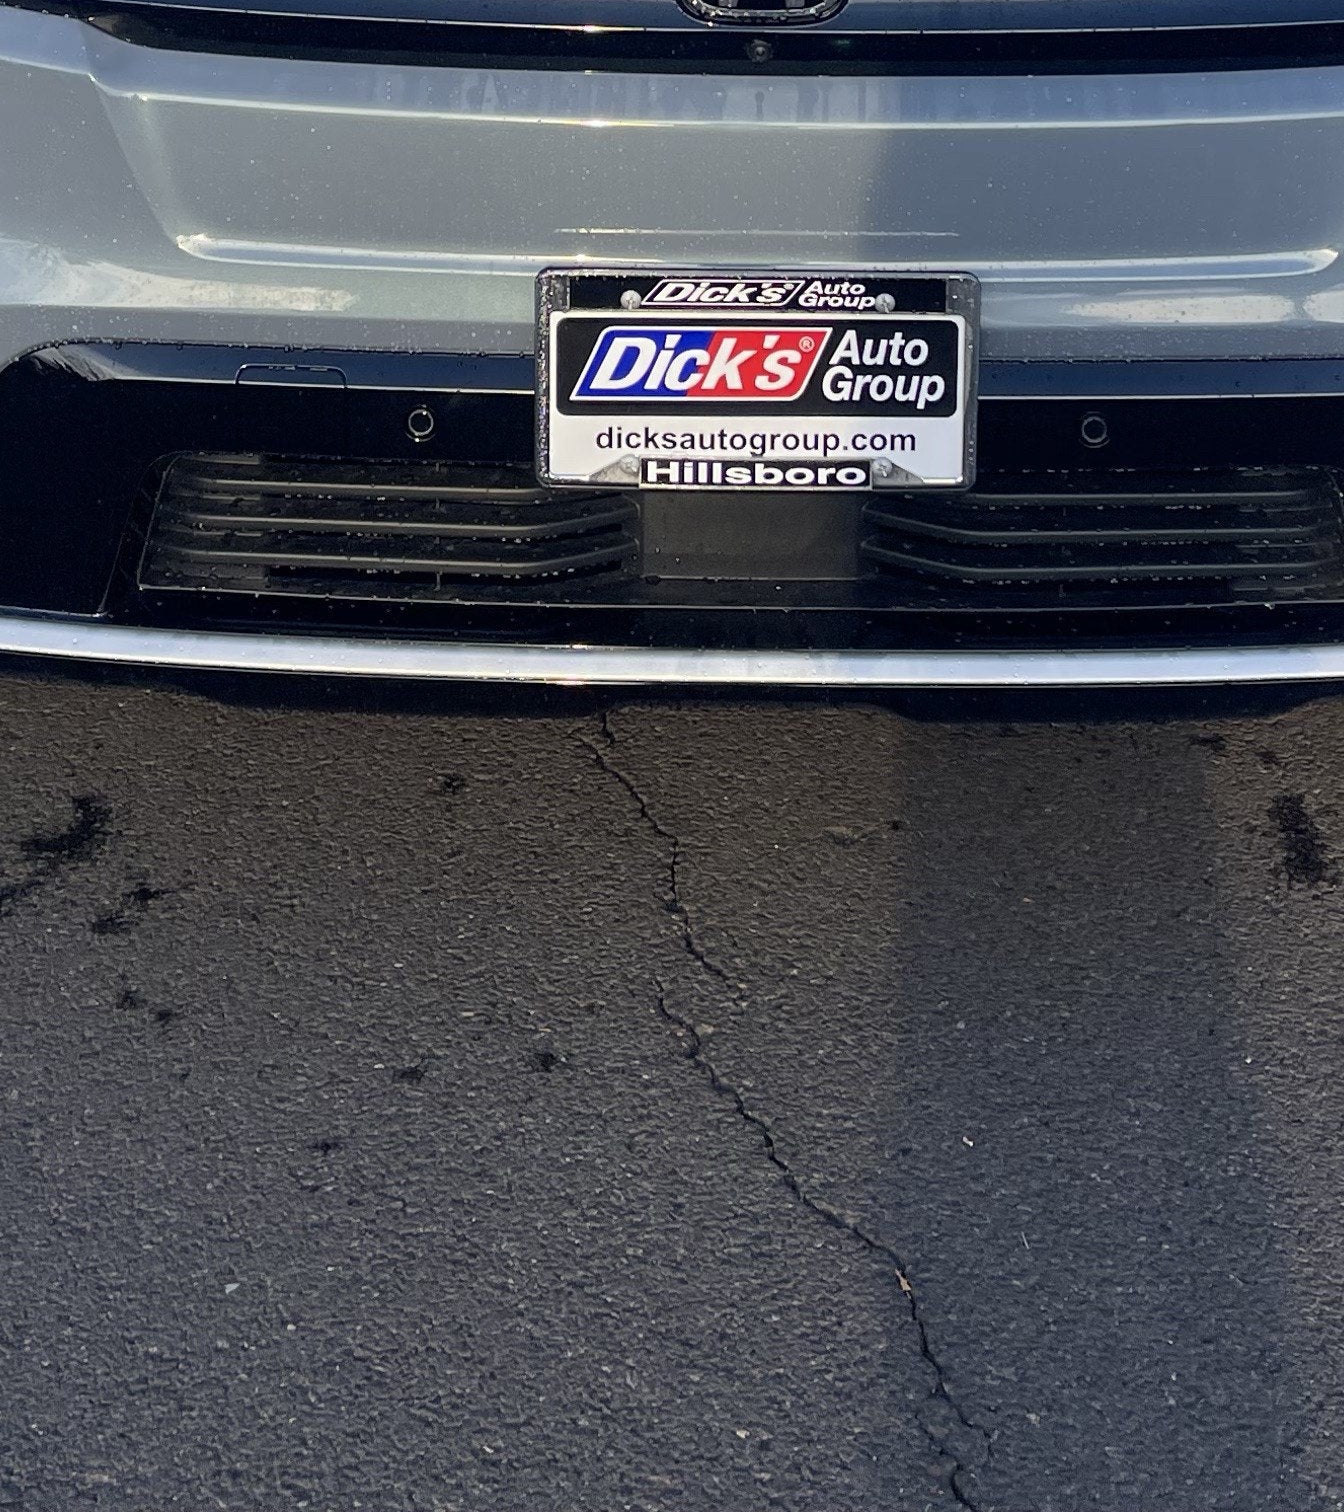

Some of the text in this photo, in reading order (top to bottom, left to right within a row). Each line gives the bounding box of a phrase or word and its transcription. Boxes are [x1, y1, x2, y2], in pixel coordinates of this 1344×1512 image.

[653, 281, 786, 303] Dick's
[798, 293, 876, 310] Group
[804, 280, 866, 295] Auto
[829, 329, 929, 367] Auto
[589, 334, 803, 391] Dick's
[822, 365, 945, 410] Group
[595, 426, 917, 456] dicksautogroup.com
[645, 460, 867, 486] Hillsboro
